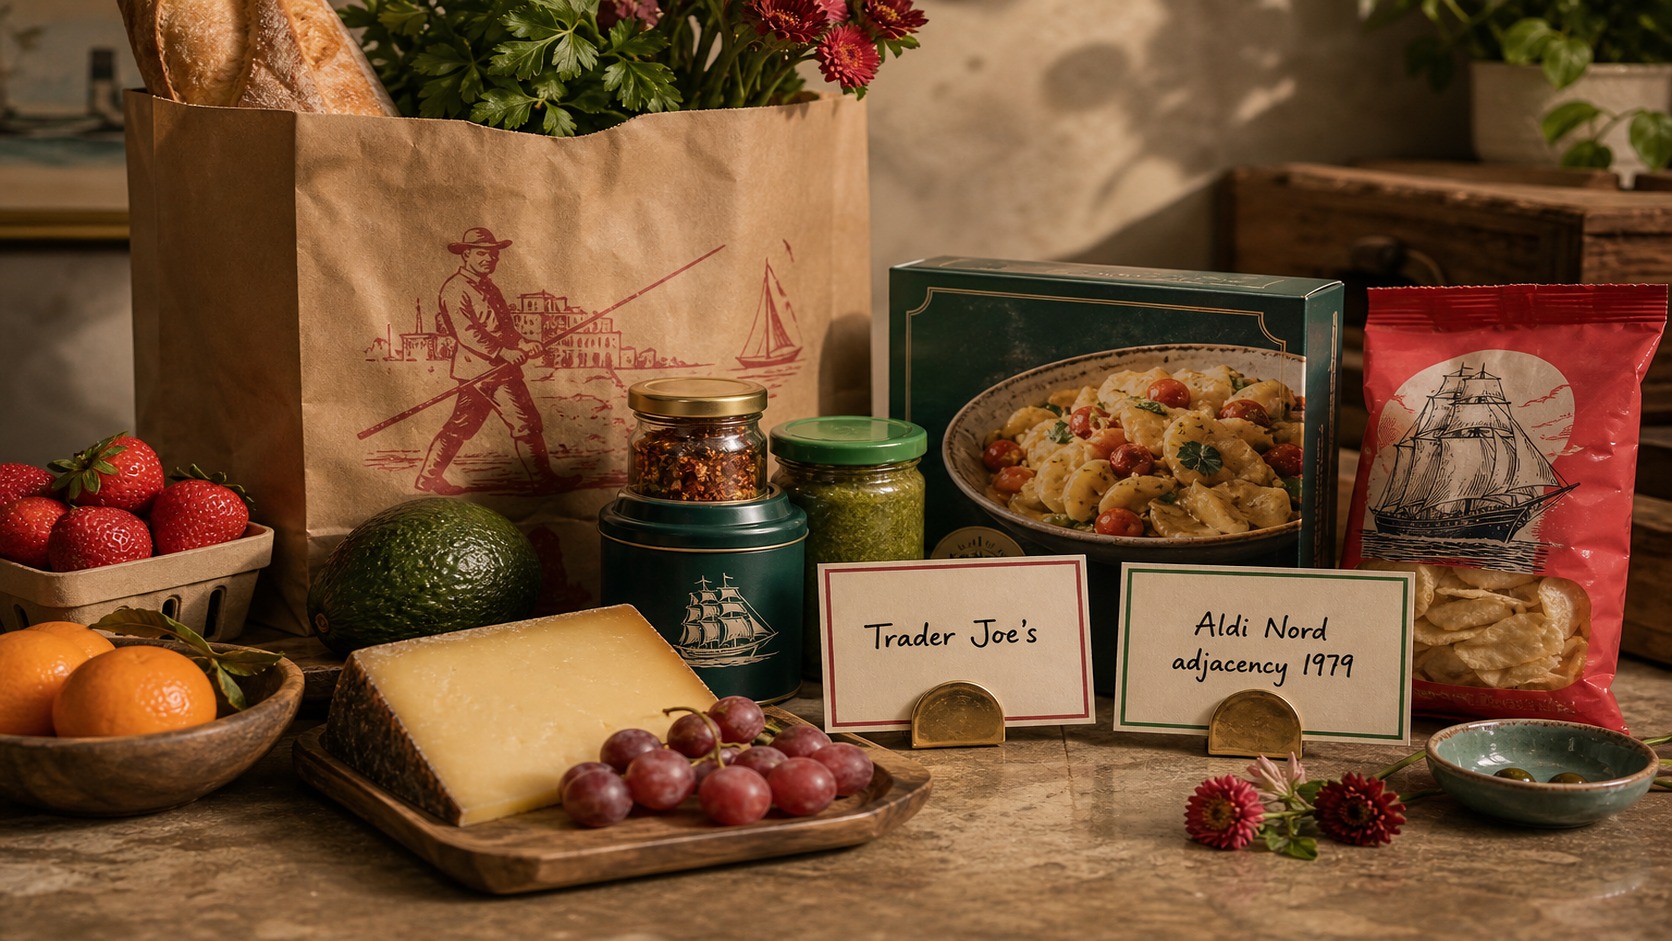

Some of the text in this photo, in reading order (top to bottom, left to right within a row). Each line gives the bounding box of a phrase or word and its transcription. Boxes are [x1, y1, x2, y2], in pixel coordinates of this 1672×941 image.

[863, 618, 1037, 650] Trader Joe's
[1194, 610, 1329, 642] Aldi Nord
[1171, 647, 1354, 688] adjacency 1979
